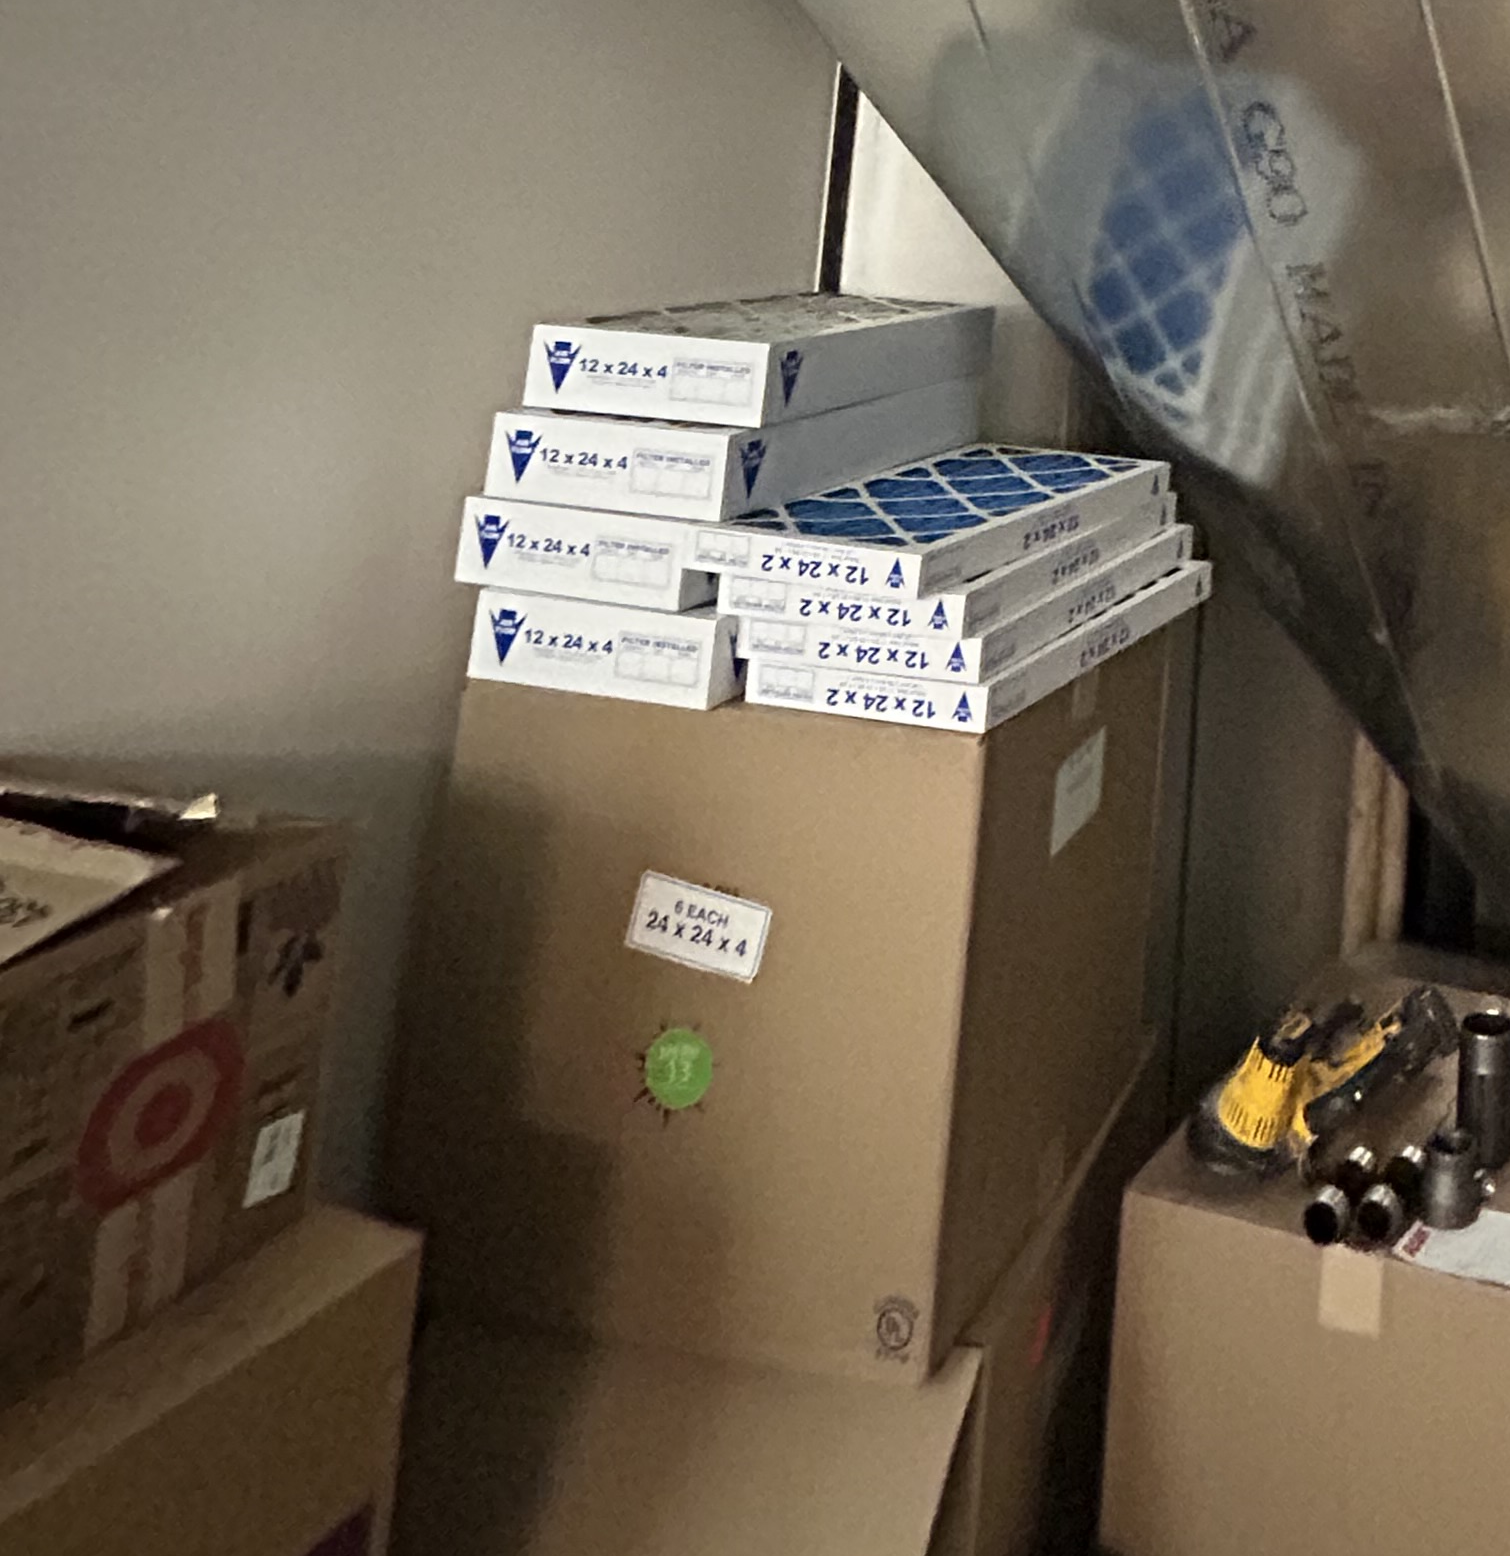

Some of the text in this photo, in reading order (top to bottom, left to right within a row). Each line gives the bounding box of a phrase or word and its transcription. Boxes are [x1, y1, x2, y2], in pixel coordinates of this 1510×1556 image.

[579, 358, 599, 373] 12
[604, 364, 613, 374] x
[618, 362, 638, 376] 24
[644, 368, 652, 377] x
[657, 367, 667, 378] 4
[540, 448, 628, 469] 12 x 24 x 4
[507, 534, 590, 556] 12 x 24 x 4
[760, 554, 774, 571] 2
[778, 556, 791, 571] x
[798, 559, 821, 578] 24
[828, 564, 840, 578] x
[846, 565, 868, 584] 12
[799, 598, 812, 616] 2
[818, 600, 830, 614] x
[837, 602, 862, 621] 24
[869, 606, 882, 620] x
[887, 606, 910, 626] 12
[525, 630, 613, 655] 12 x 24 x 4
[818, 642, 830, 658] 2
[836, 644, 848, 658] x
[855, 646, 880, 664] 24
[886, 648, 899, 662] x
[904, 650, 929, 669] 12
[826, 688, 838, 706] 2
[844, 690, 856, 706] x
[863, 692, 888, 712] 24
[894, 697, 906, 712] x
[911, 698, 936, 718] 12
[675, 901, 729, 926] 6 EACH
[645, 911, 747, 956] 24 x 24 x 4
